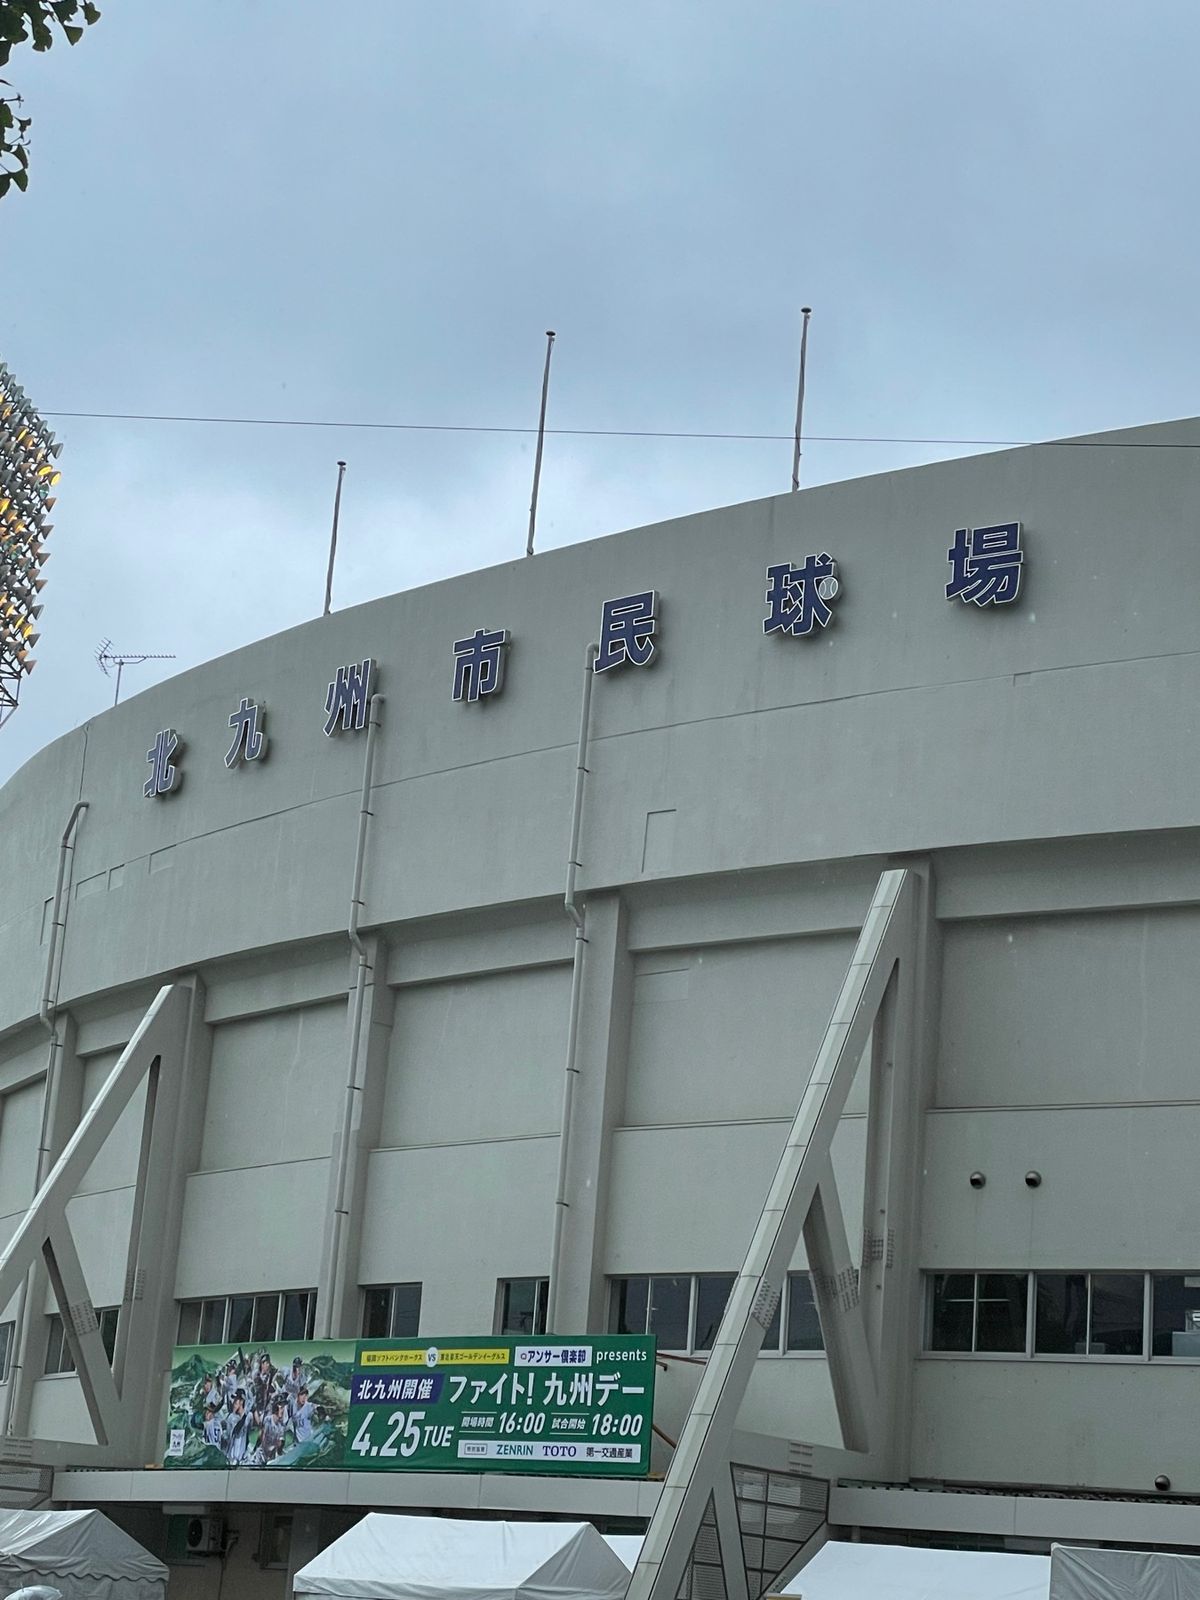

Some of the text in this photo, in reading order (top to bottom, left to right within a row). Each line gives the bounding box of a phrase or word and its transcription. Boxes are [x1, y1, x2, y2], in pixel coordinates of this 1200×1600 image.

[143, 521, 1024, 798] 北九州市民球場
[596, 1349, 647, 1364] presents
[357, 1379, 434, 1401] 北九州開催
[351, 1411, 454, 1457] 4.25 TUE
[499, 1412, 546, 1434] 16:00
[551, 1413, 643, 1437] 試合開始 18:00
[496, 1444, 534, 1456] ZENRIN
[542, 1445, 577, 1457] TOTO
